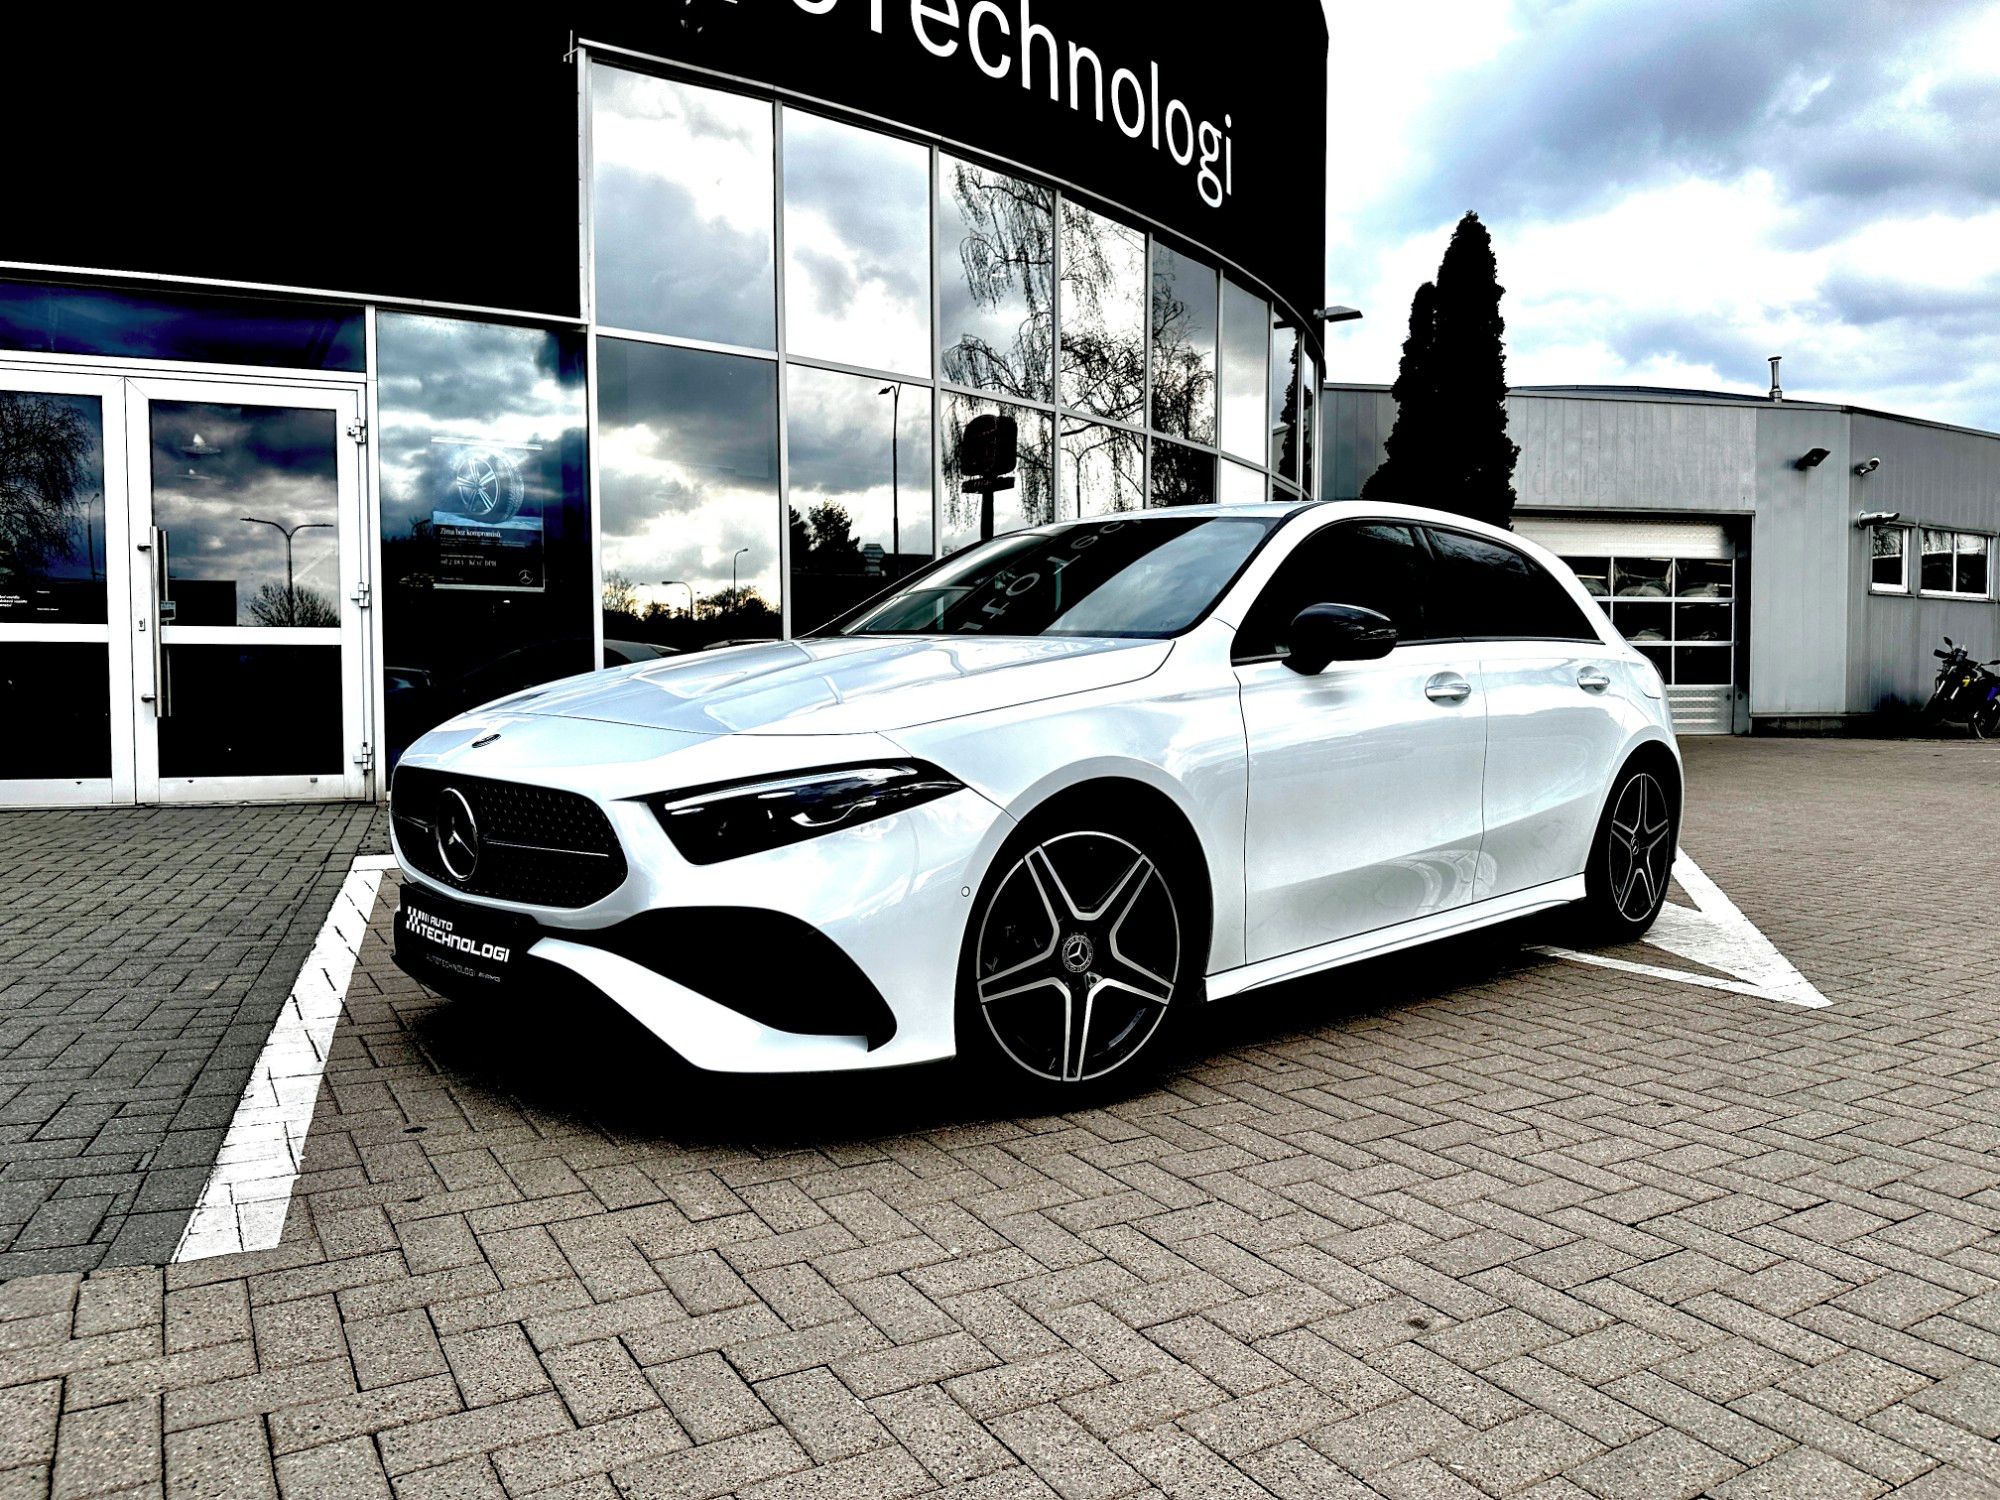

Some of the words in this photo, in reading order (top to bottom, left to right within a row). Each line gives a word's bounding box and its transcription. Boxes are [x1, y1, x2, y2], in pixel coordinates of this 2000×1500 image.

[792, 0, 1232, 208] echnologi
[421, 923, 511, 963] TECHNOLOGI
[430, 915, 453, 932] AUTO
